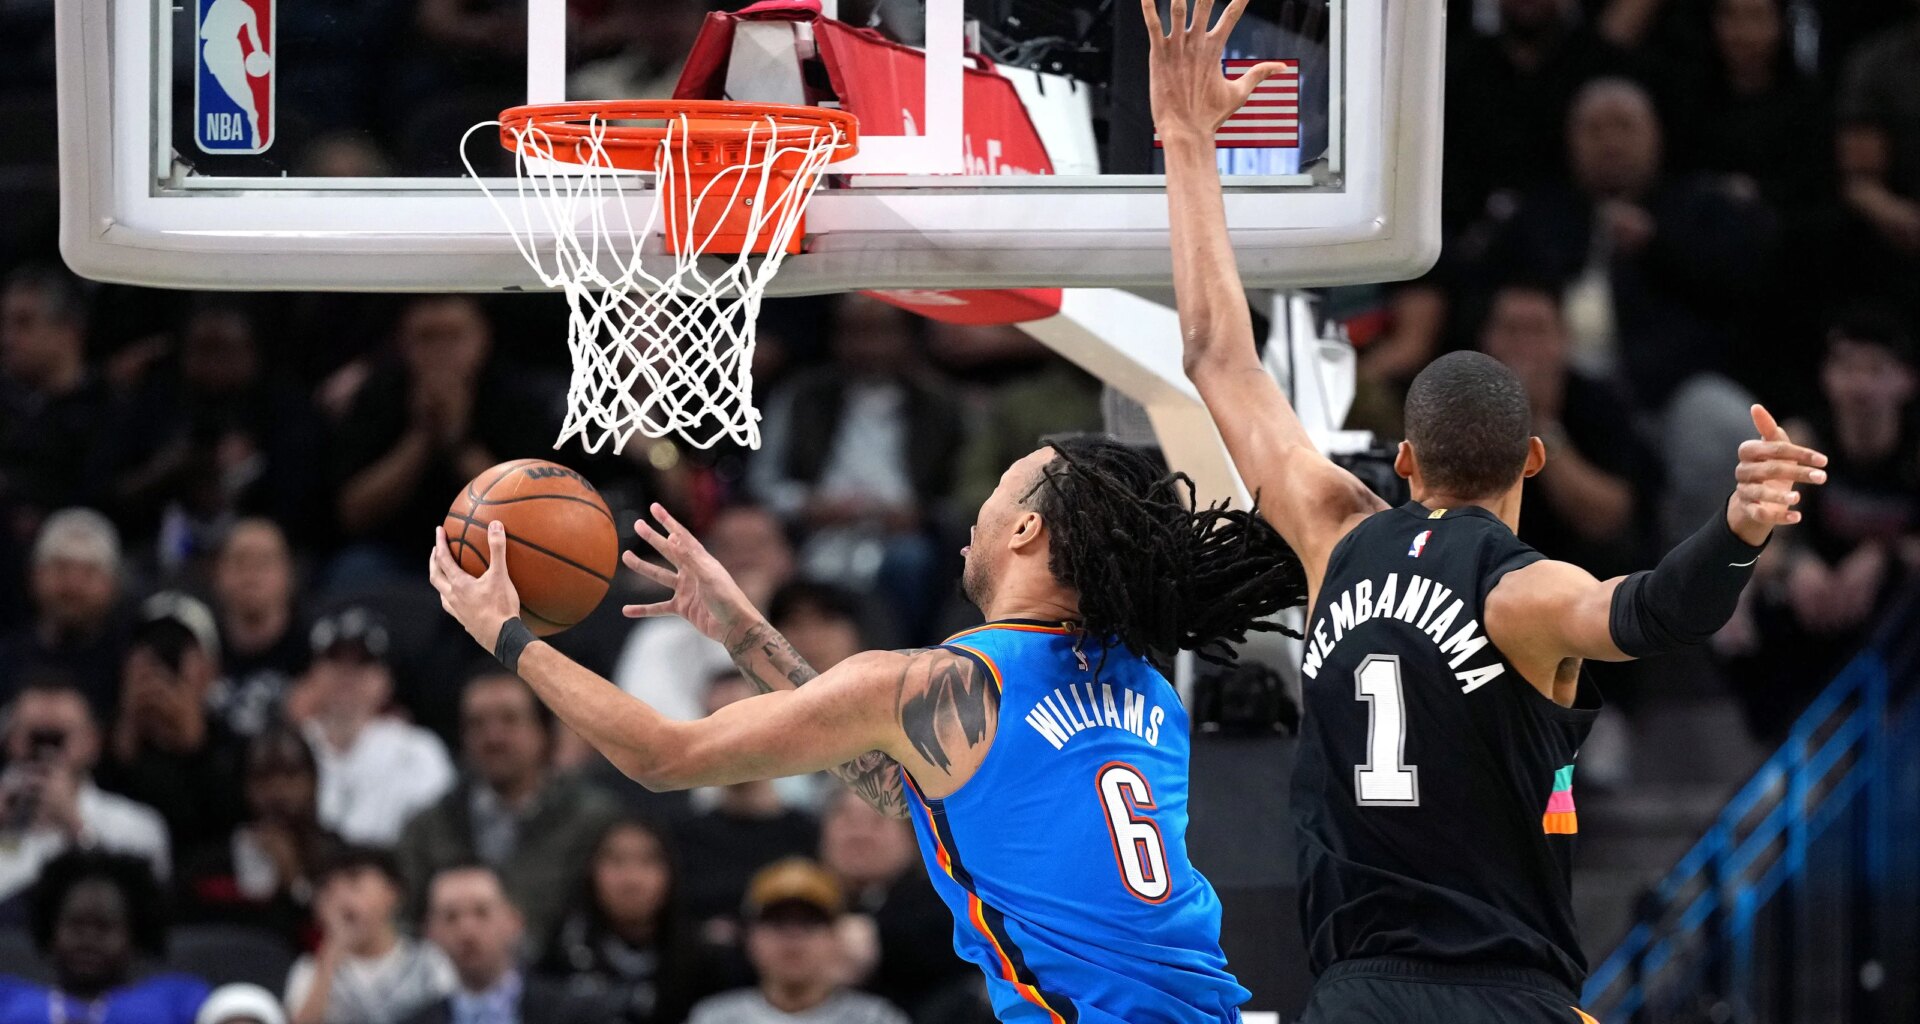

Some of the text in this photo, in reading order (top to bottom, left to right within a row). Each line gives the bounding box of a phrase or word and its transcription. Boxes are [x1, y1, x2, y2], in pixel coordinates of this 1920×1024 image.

[206, 112, 244, 141] NBA
[1302, 572, 1506, 695] WEMBANYAMA
[1024, 682, 1165, 751] WILLIAMS
[1354, 653, 1420, 807] 1
[1094, 760, 1173, 905] 6
